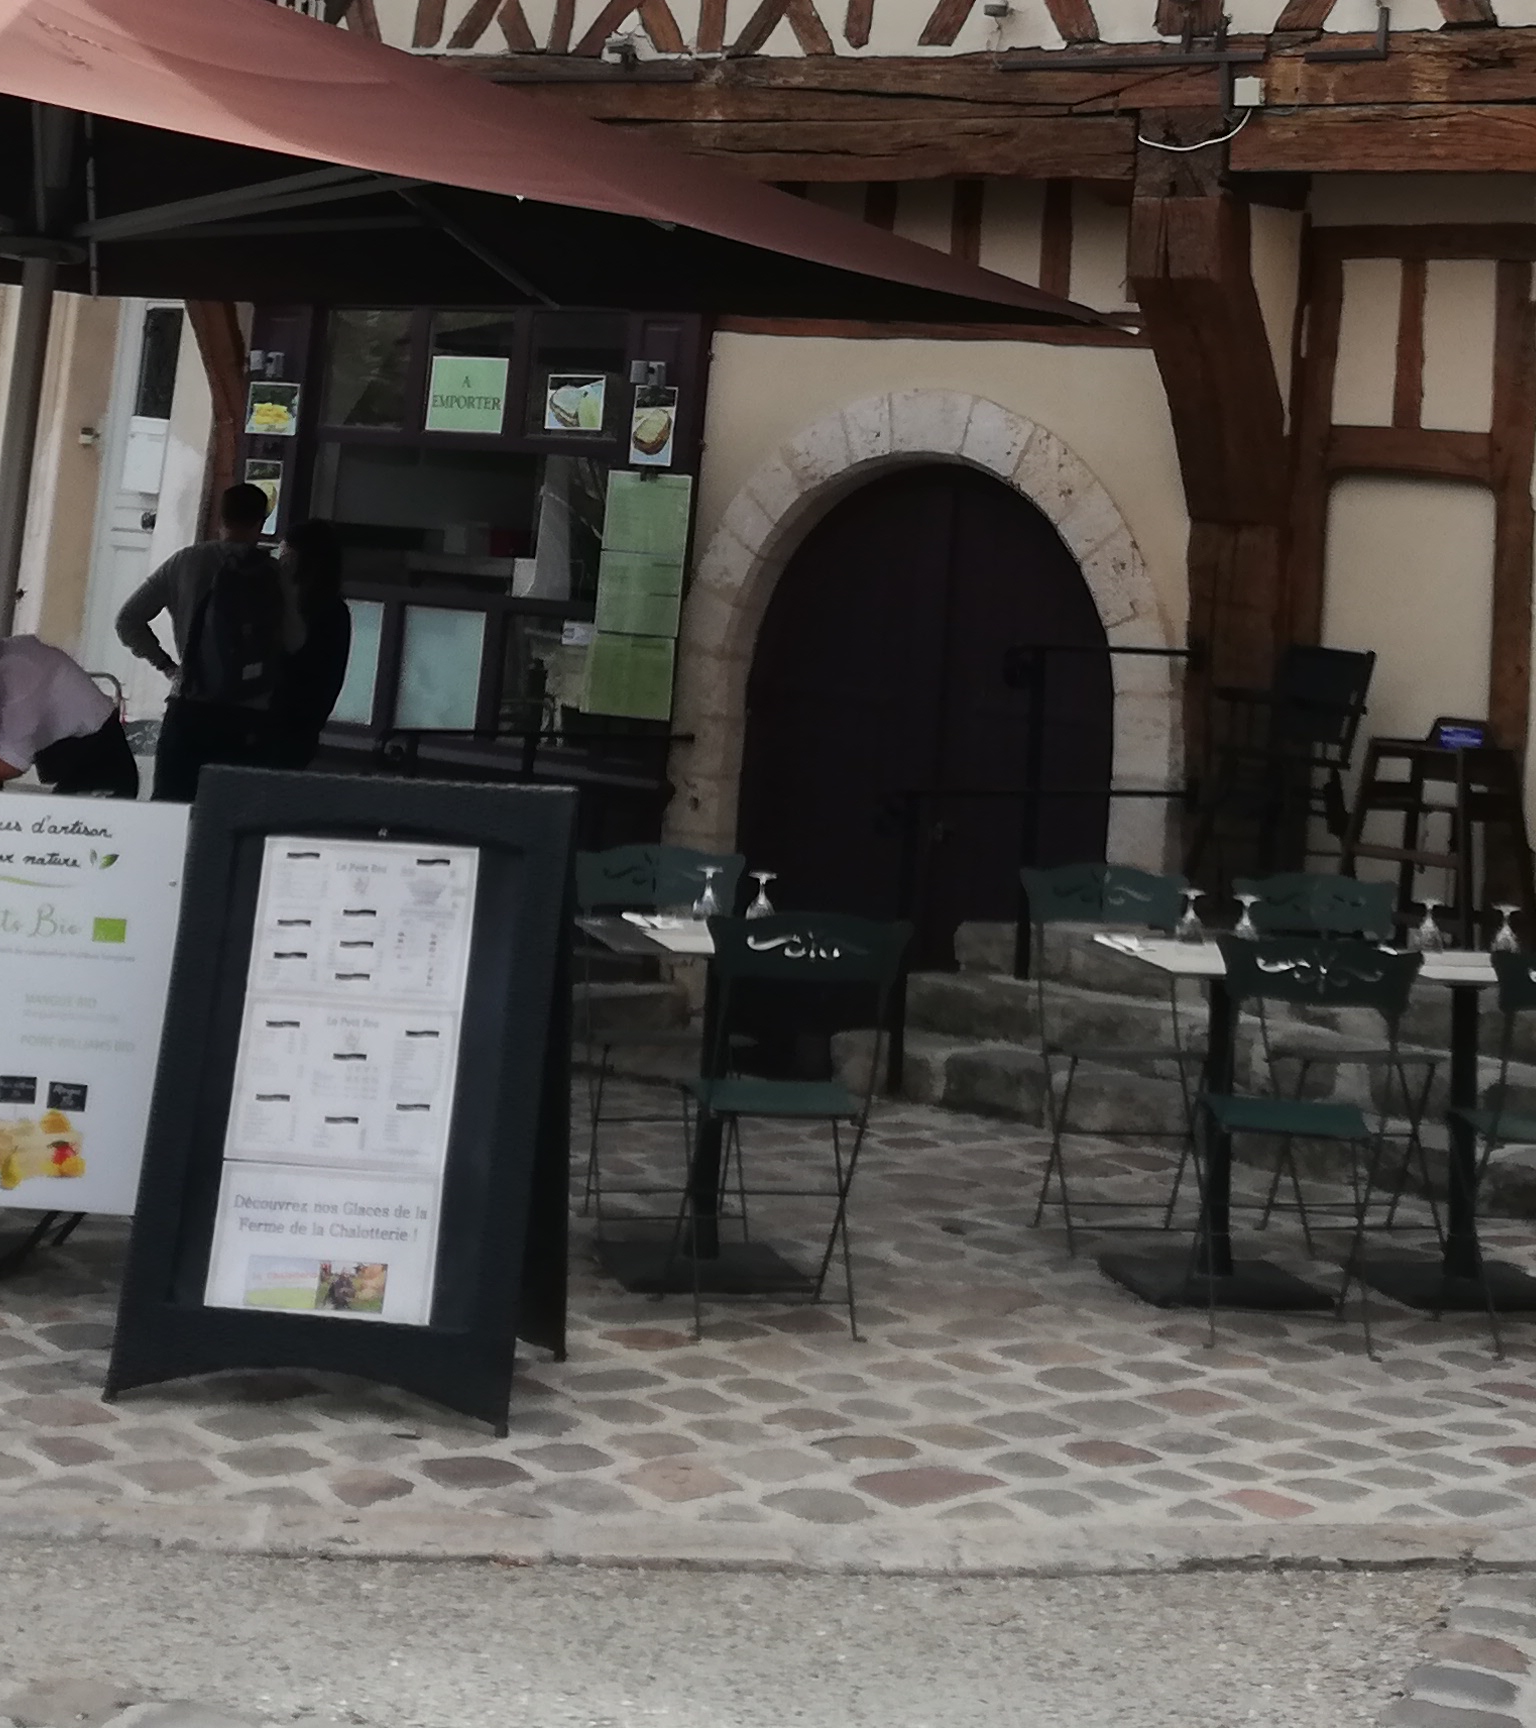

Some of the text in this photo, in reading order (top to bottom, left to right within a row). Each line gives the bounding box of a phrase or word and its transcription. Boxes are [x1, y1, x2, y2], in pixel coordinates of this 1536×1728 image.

[432, 394, 502, 411] EMPORTER
[23, 851, 81, 869] nature
[27, 902, 82, 938] Bio
[233, 1193, 428, 1220] Découvrez nos Glaces de la
[238, 1216, 285, 1234] Ferme
[289, 1221, 308, 1236] de
[312, 1222, 324, 1237] la
[328, 1223, 409, 1242] Chalotterie
